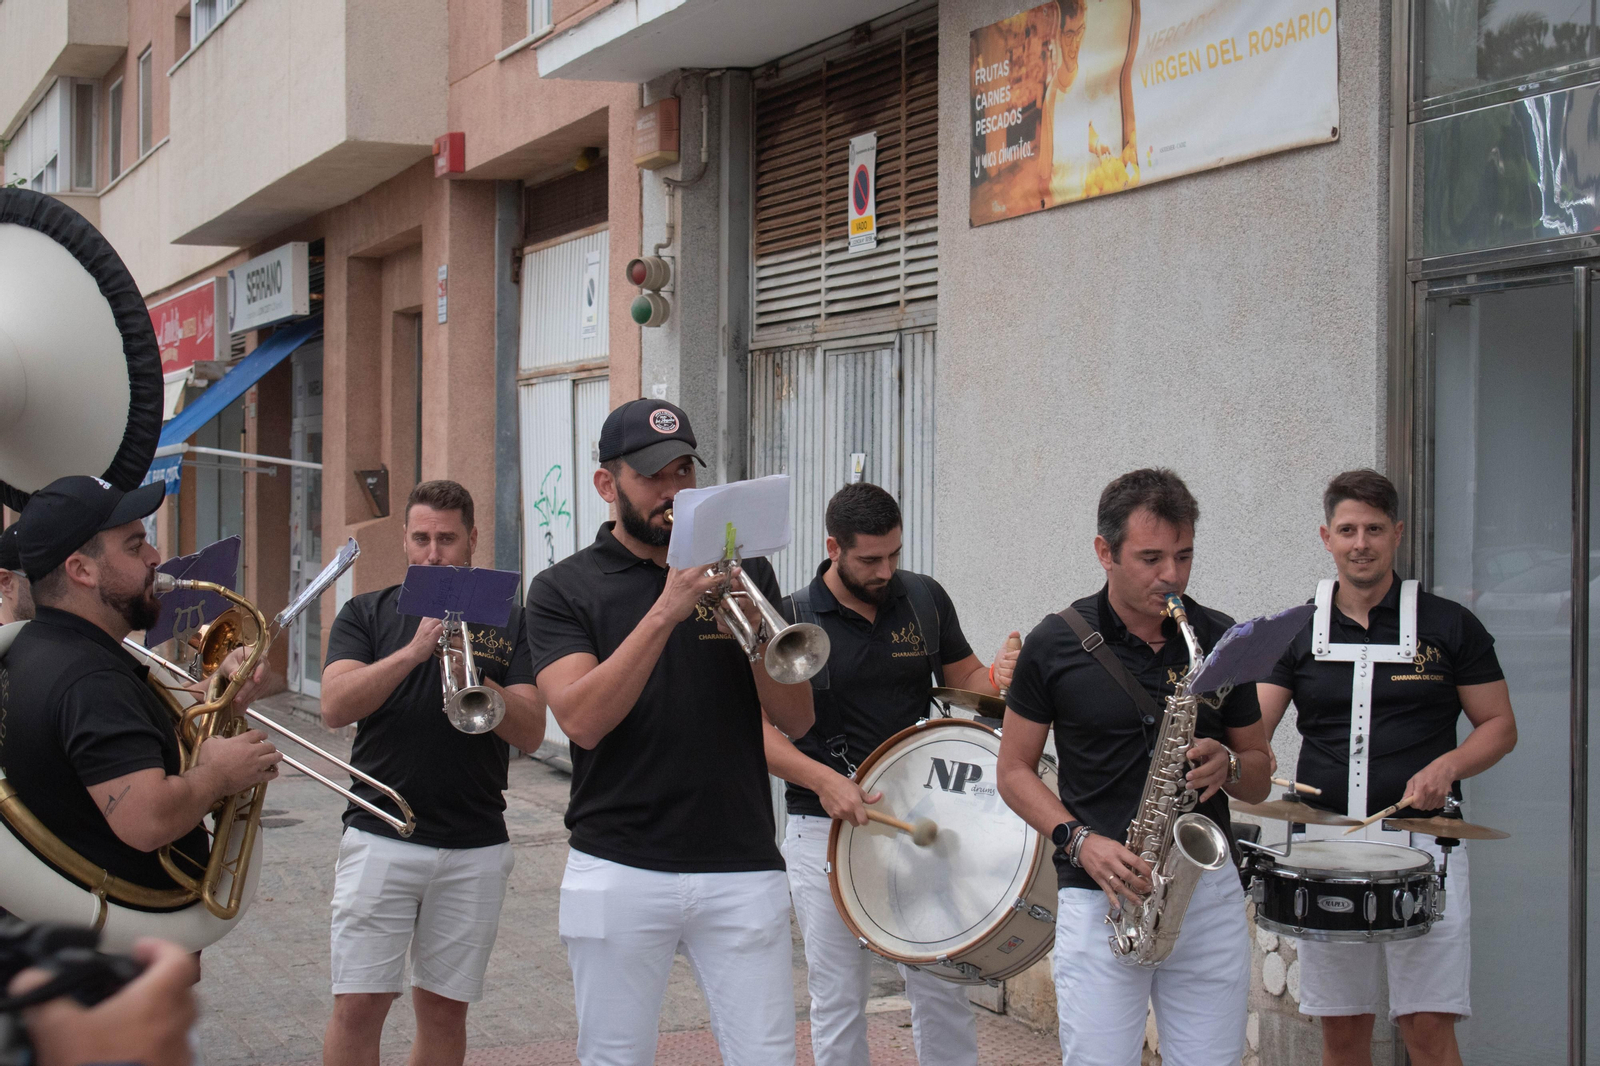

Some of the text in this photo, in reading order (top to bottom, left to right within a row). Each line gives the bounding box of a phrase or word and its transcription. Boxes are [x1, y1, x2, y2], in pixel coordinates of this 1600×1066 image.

[1140, 6, 1332, 89] VIRGEN DEL ROSARIO
[975, 60, 1010, 85] FRUTAS
[975, 85, 1012, 111] CARNES
[975, 107, 1023, 136] PESCADOS
[856, 220, 868, 232] VADO
[246, 259, 283, 305] SERRANO
[922, 756, 983, 795] NP
[970, 784, 996, 796] drums
